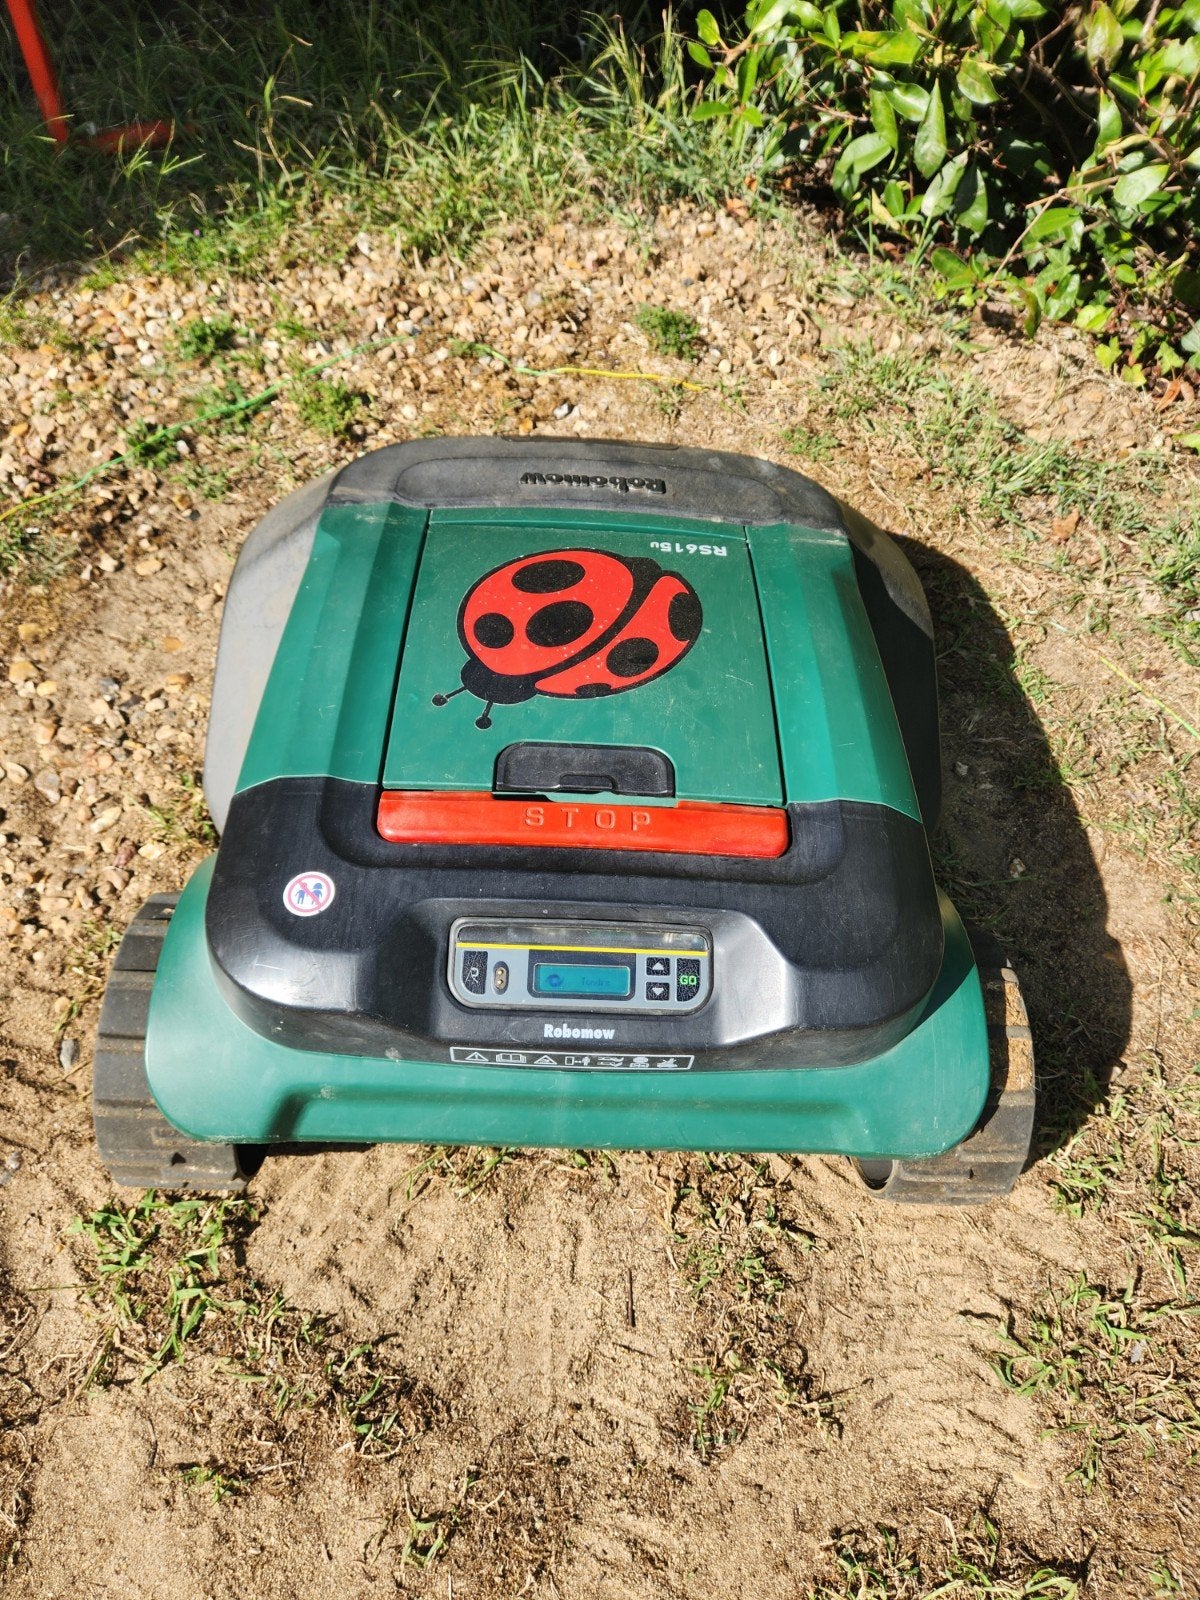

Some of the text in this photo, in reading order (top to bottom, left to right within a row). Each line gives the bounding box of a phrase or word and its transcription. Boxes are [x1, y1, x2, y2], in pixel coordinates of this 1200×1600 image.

[519, 471, 667, 495] Robomow
[650, 541, 727, 557] RS615u
[524, 806, 650, 831] STOP
[679, 975, 697, 986] GO
[543, 1023, 616, 1040] Robomow
